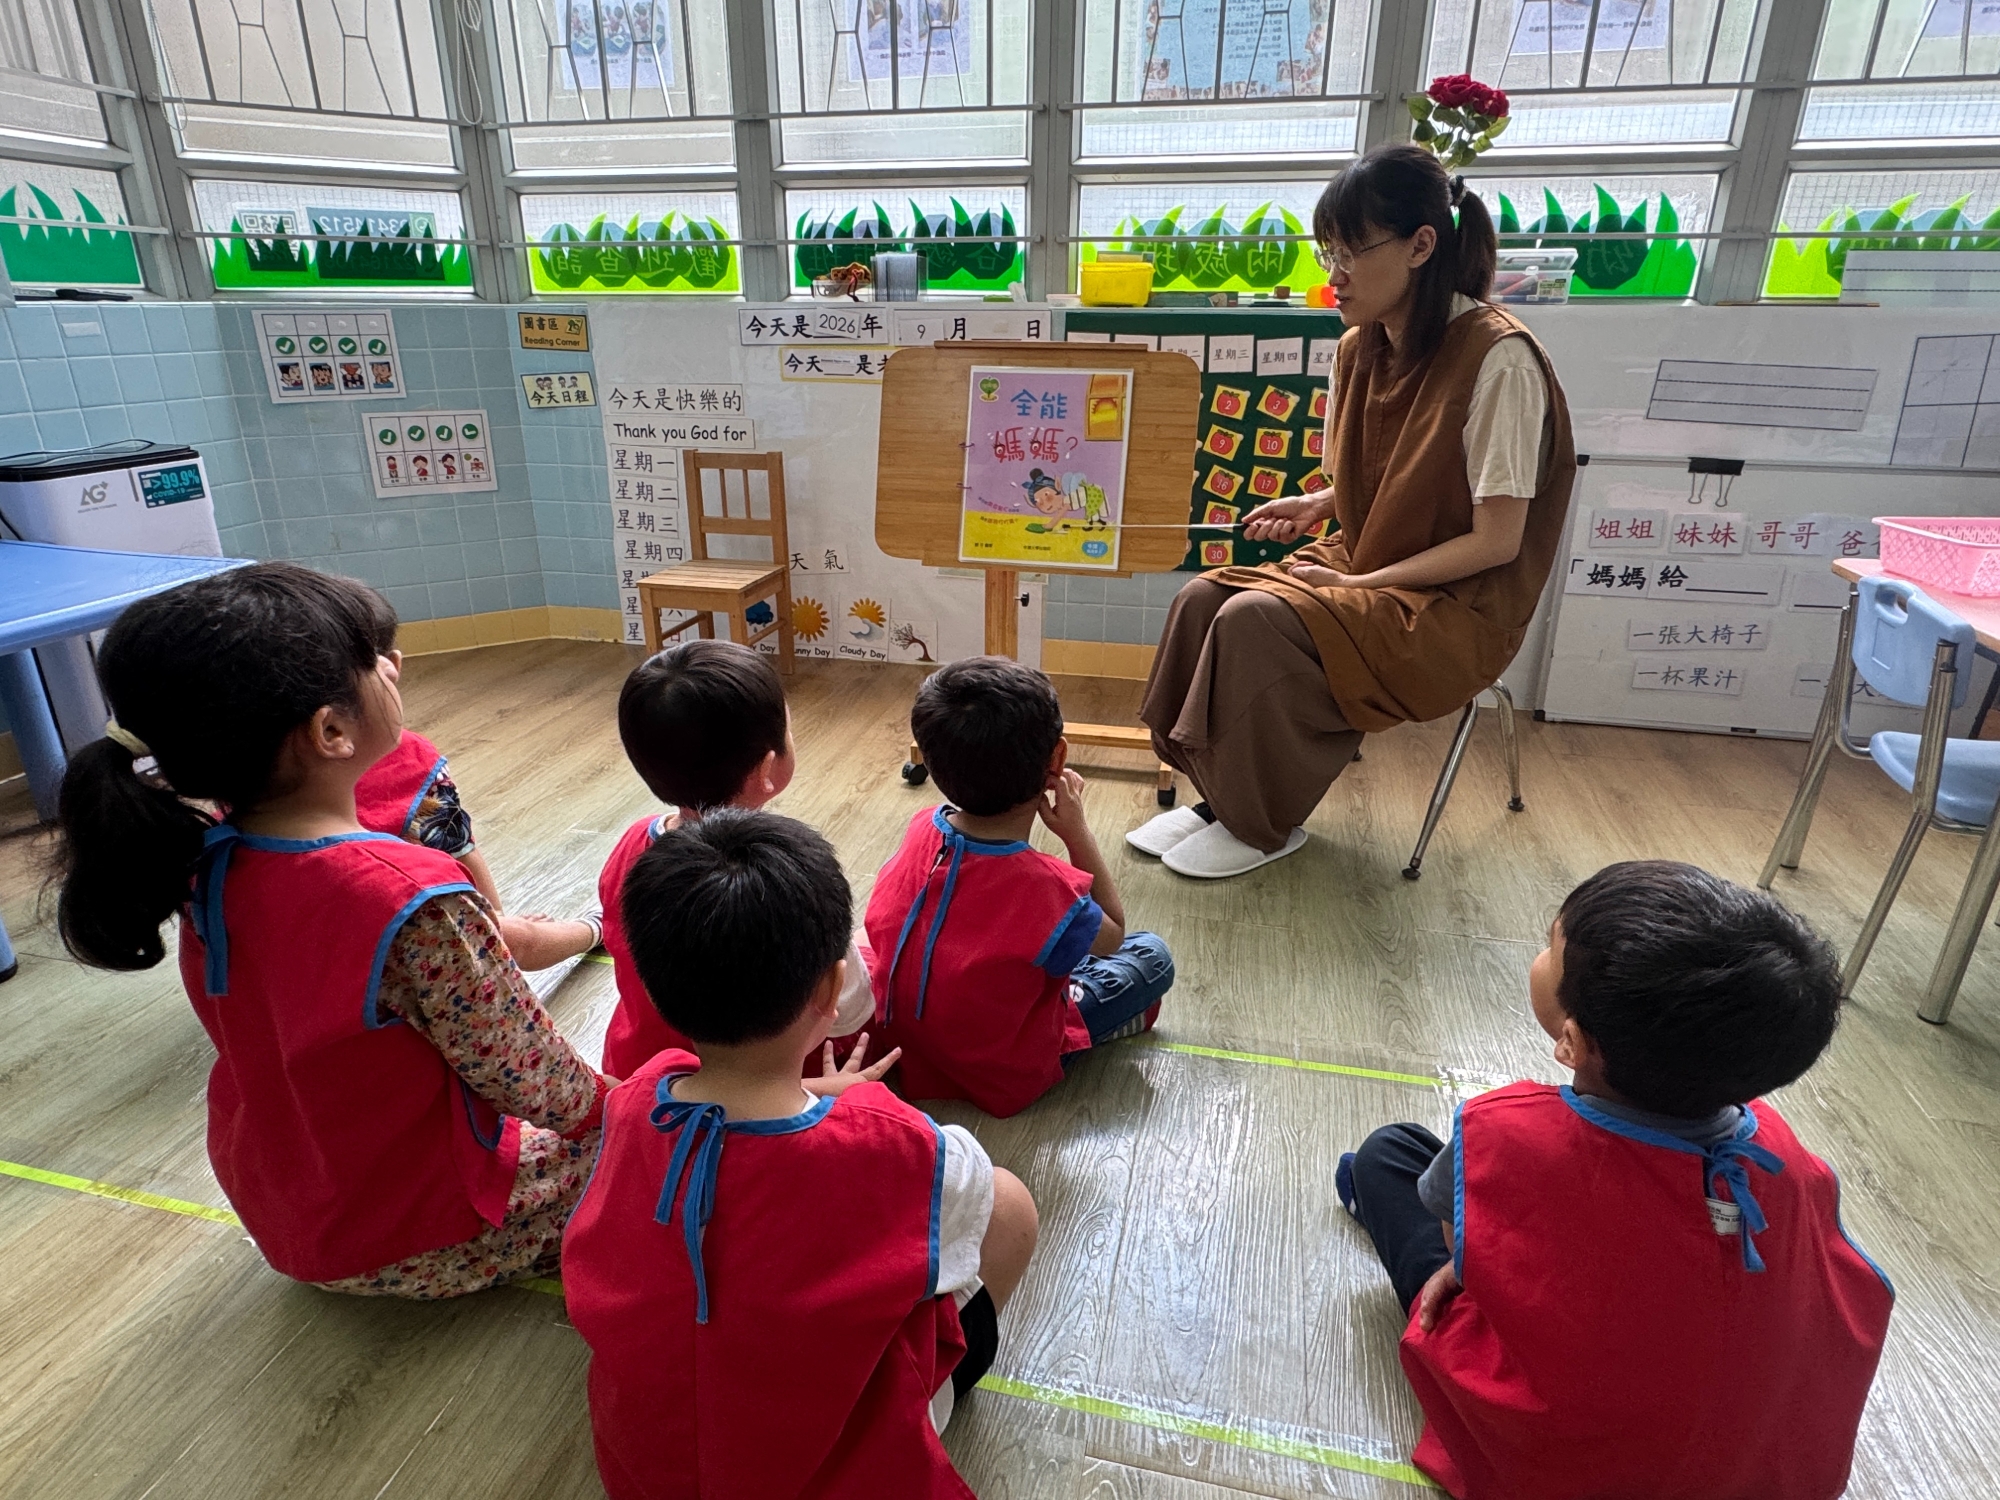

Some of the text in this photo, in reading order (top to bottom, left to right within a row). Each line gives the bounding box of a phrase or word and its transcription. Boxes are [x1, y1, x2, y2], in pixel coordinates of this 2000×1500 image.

[524, 316, 559, 331] 圖書區
[917, 317, 1041, 341] 9 月 日
[524, 336, 580, 347] Reading Corner
[1213, 348, 1250, 361] 星期三
[1261, 351, 1298, 364] 星期四
[784, 353, 824, 373] 今天
[530, 389, 590, 405] 今天日程
[608, 387, 741, 412] 今天是快樂的
[1010, 388, 1068, 419] 全能
[1225, 400, 1232, 410] 2
[1272, 400, 1281, 410] 3
[613, 422, 747, 443] Thank you God for
[1219, 439, 1226, 449] 9
[1266, 439, 1278, 451] 10
[614, 449, 675, 473] 星期一
[615, 479, 678, 503] 星期二
[1216, 476, 1229, 491] 16
[1261, 478, 1272, 490] 17
[616, 509, 678, 533] 星期三
[1215, 513, 1226, 525] 23
[1594, 517, 1655, 540] 姐姐
[1674, 521, 1738, 548] 妹妹
[1756, 520, 1821, 549] 哥哥
[624, 539, 684, 562] 星期四
[1836, 530, 1880, 556] 爸
[1211, 550, 1223, 559] 30
[1633, 623, 1763, 645] 一張大椅子
[760, 643, 776, 653] Day
[814, 647, 831, 658] Day
[839, 645, 886, 660] Cloudy Day
[1637, 667, 1739, 689] 一杯果汁
